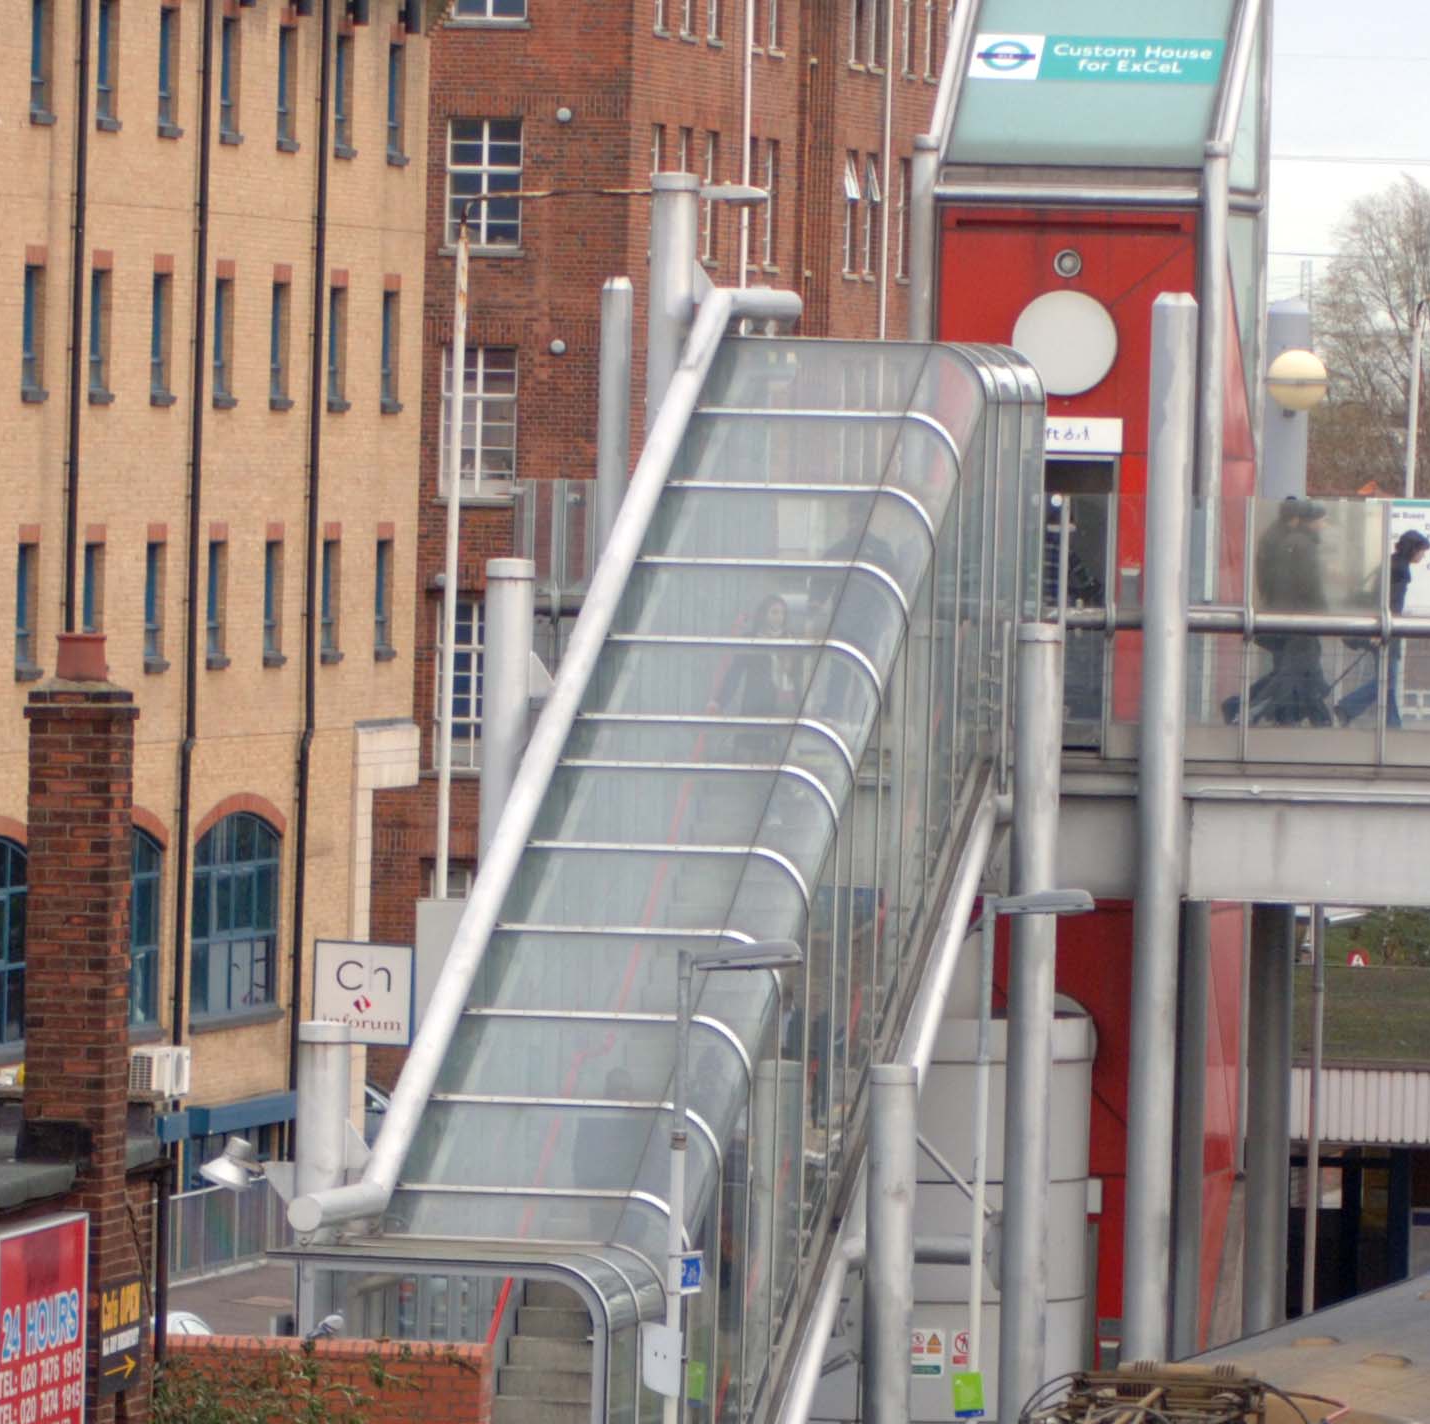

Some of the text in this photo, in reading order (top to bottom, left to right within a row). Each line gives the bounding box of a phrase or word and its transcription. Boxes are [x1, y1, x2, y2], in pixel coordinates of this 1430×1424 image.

[1053, 44, 1213, 60] Custom House
[1078, 58, 1183, 74] for ExCeL
[2, 1304, 22, 1364] 24
[25, 1288, 80, 1357] HOURS
[21, 1361, 38, 1392] 020
[63, 1347, 82, 1379] 1915
